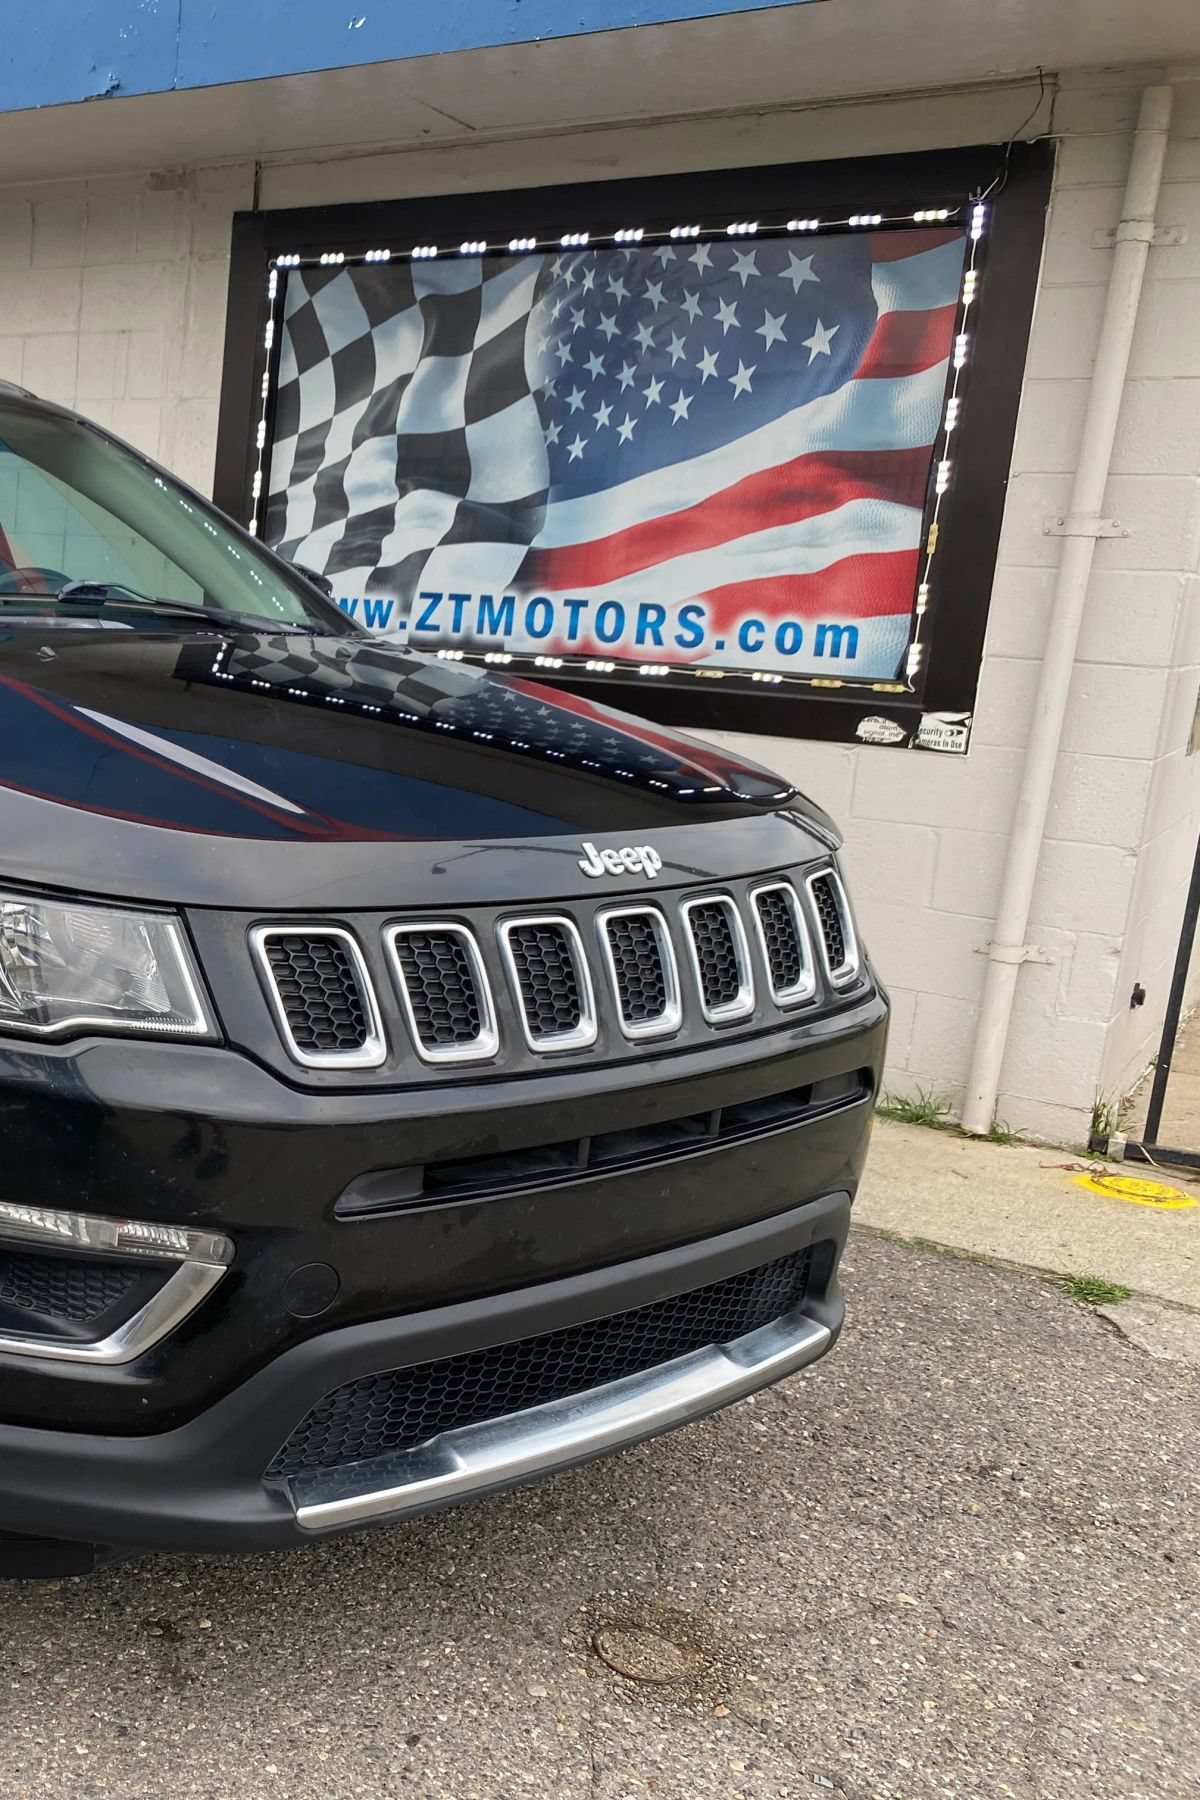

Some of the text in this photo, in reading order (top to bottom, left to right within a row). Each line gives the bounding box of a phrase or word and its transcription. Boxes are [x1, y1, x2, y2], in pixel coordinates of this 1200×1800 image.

[329, 591, 859, 660] w.ZTMOTORS.com
[918, 738, 941, 748] ameras
[950, 739, 963, 749] Use
[919, 727, 943, 738] ecurity
[577, 841, 663, 879] Jeep
